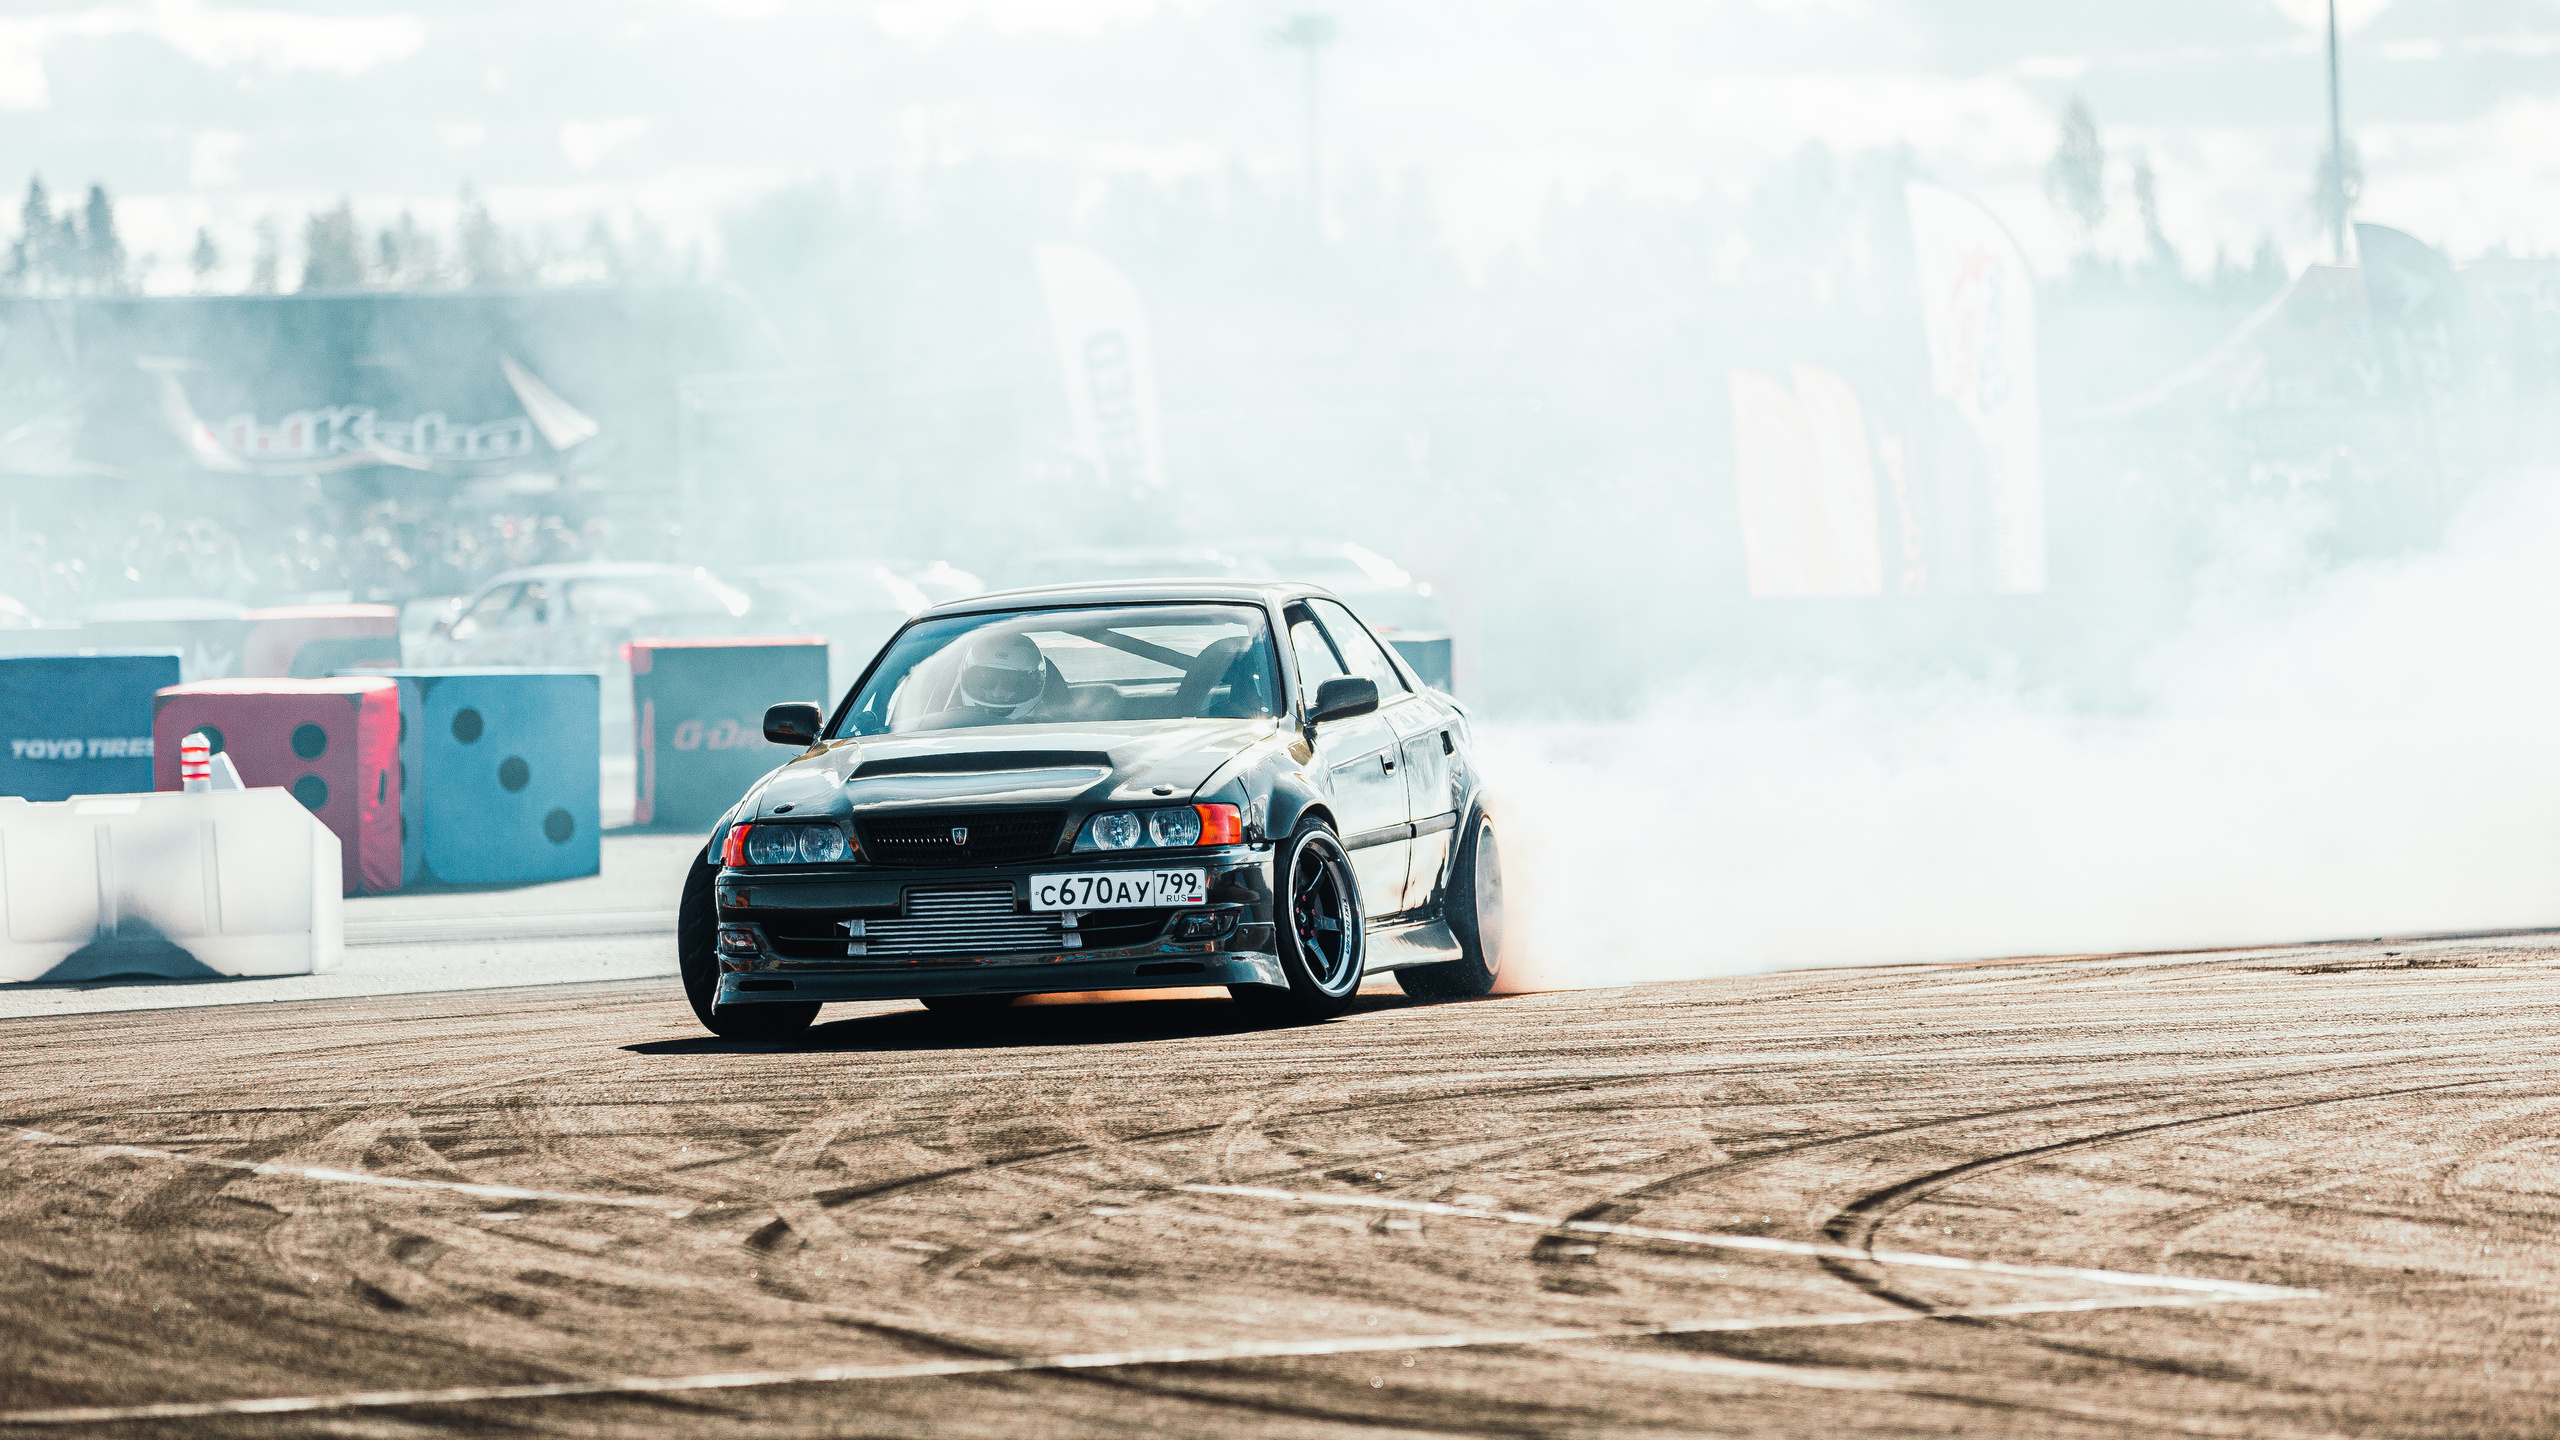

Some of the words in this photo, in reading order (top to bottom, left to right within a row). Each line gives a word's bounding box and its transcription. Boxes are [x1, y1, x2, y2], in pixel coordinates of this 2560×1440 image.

[11, 738, 84, 759] TOYO
[1156, 873, 1197, 894] 799
[1166, 894, 1187, 903] RUS
